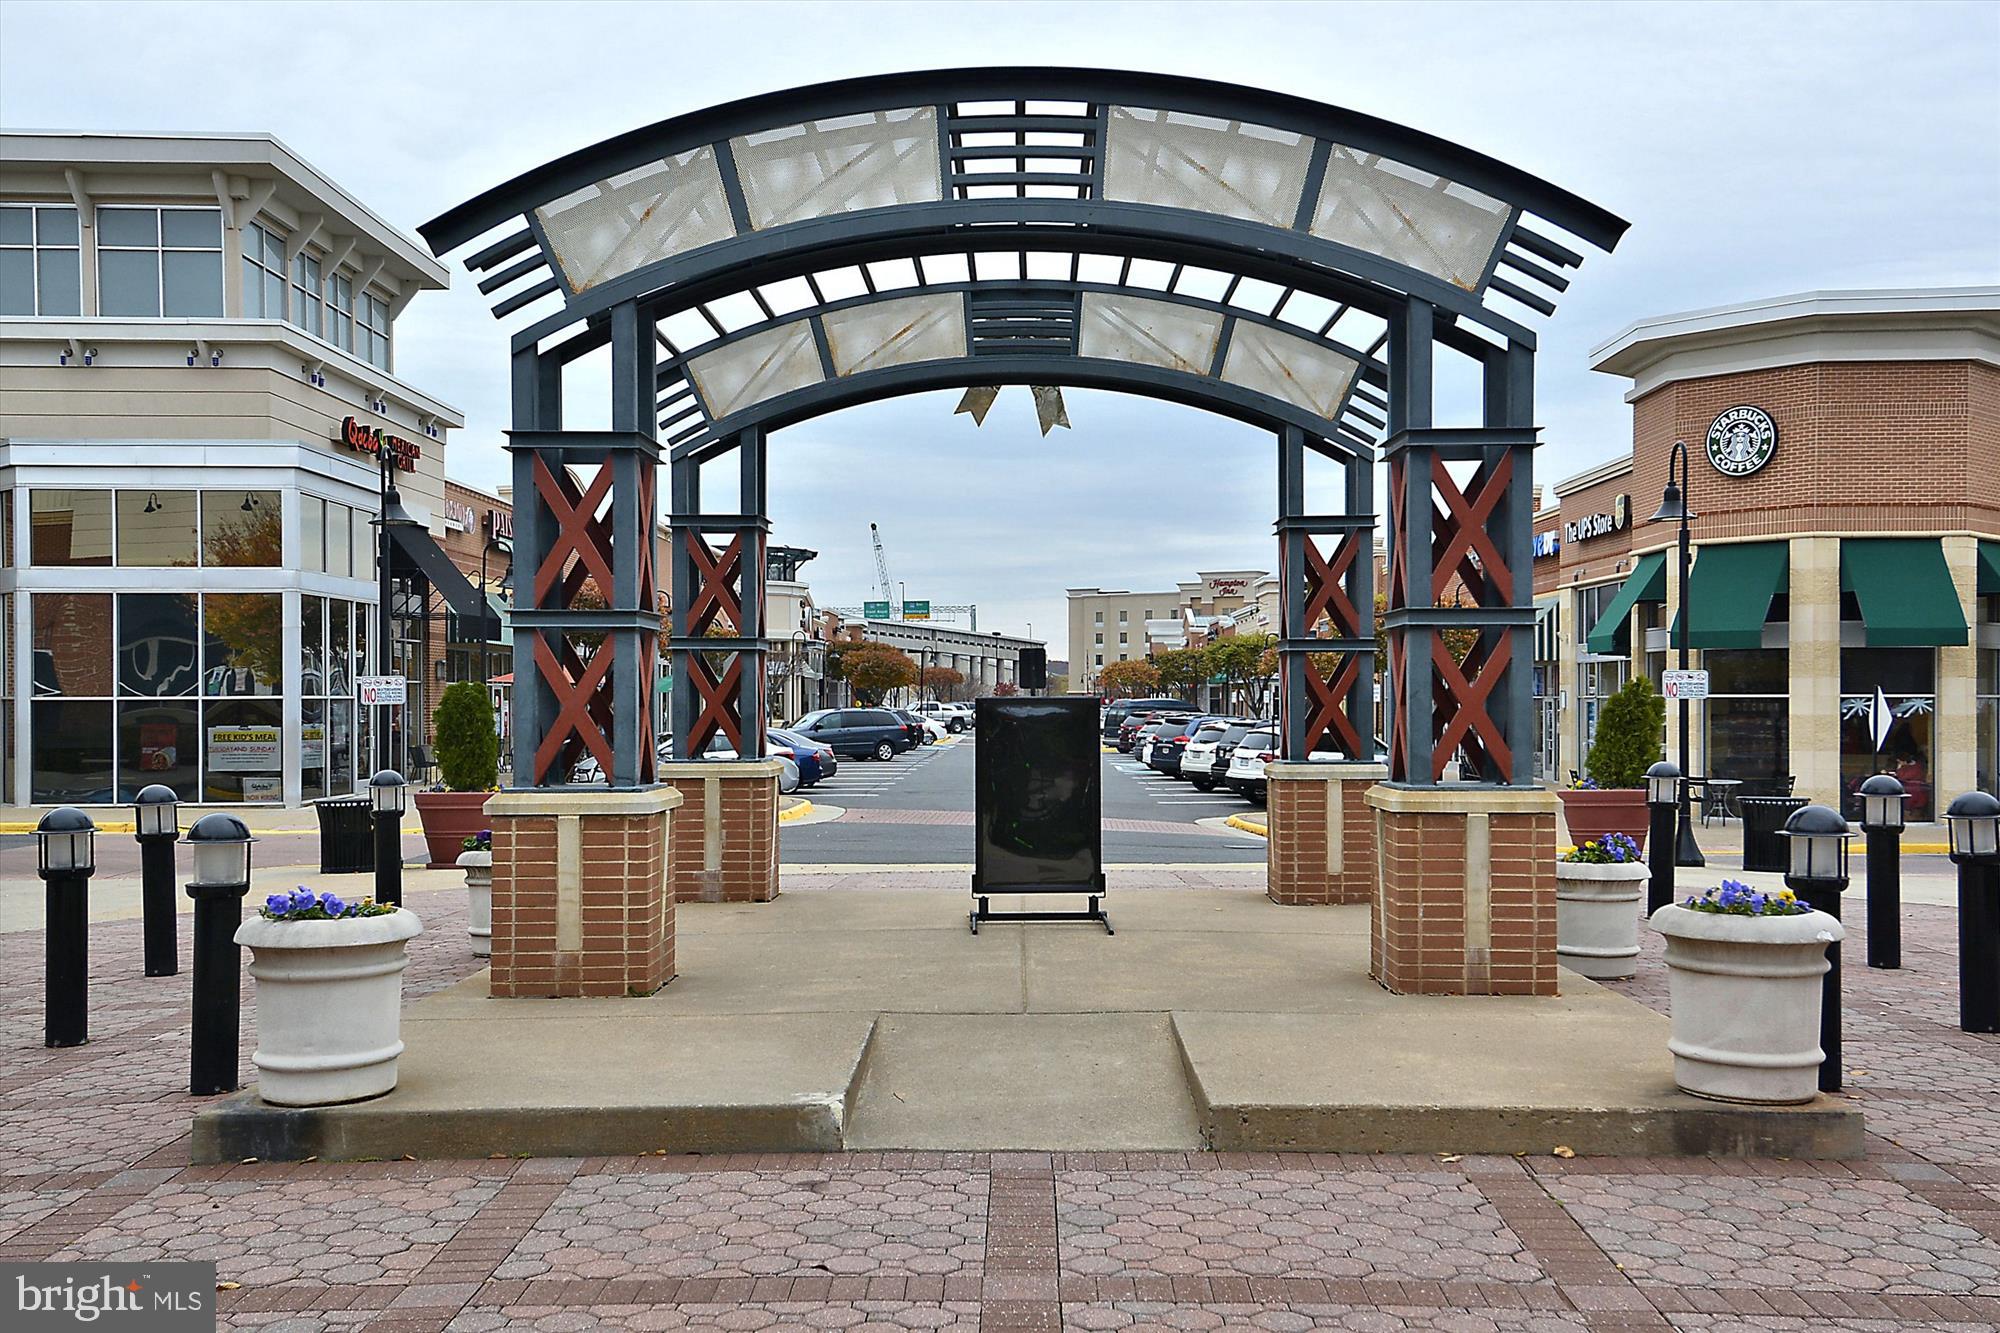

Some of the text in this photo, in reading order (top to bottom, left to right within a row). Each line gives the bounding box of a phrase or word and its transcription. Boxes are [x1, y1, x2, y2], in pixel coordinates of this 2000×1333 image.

[1711, 409, 1771, 439] STARBUCKS
[392, 437, 421, 459] MEXICAN
[397, 454, 416, 473] GRILL
[1714, 453, 1761, 472] COFFEE
[1565, 513, 1613, 544] The UPS Store
[1209, 579, 1248, 589] Hampton
[1219, 587, 1238, 596] Inn
[364, 688, 376, 703] NO
[1665, 682, 1678, 697] NO
[213, 733, 276, 741] FREE KID'S MEAL
